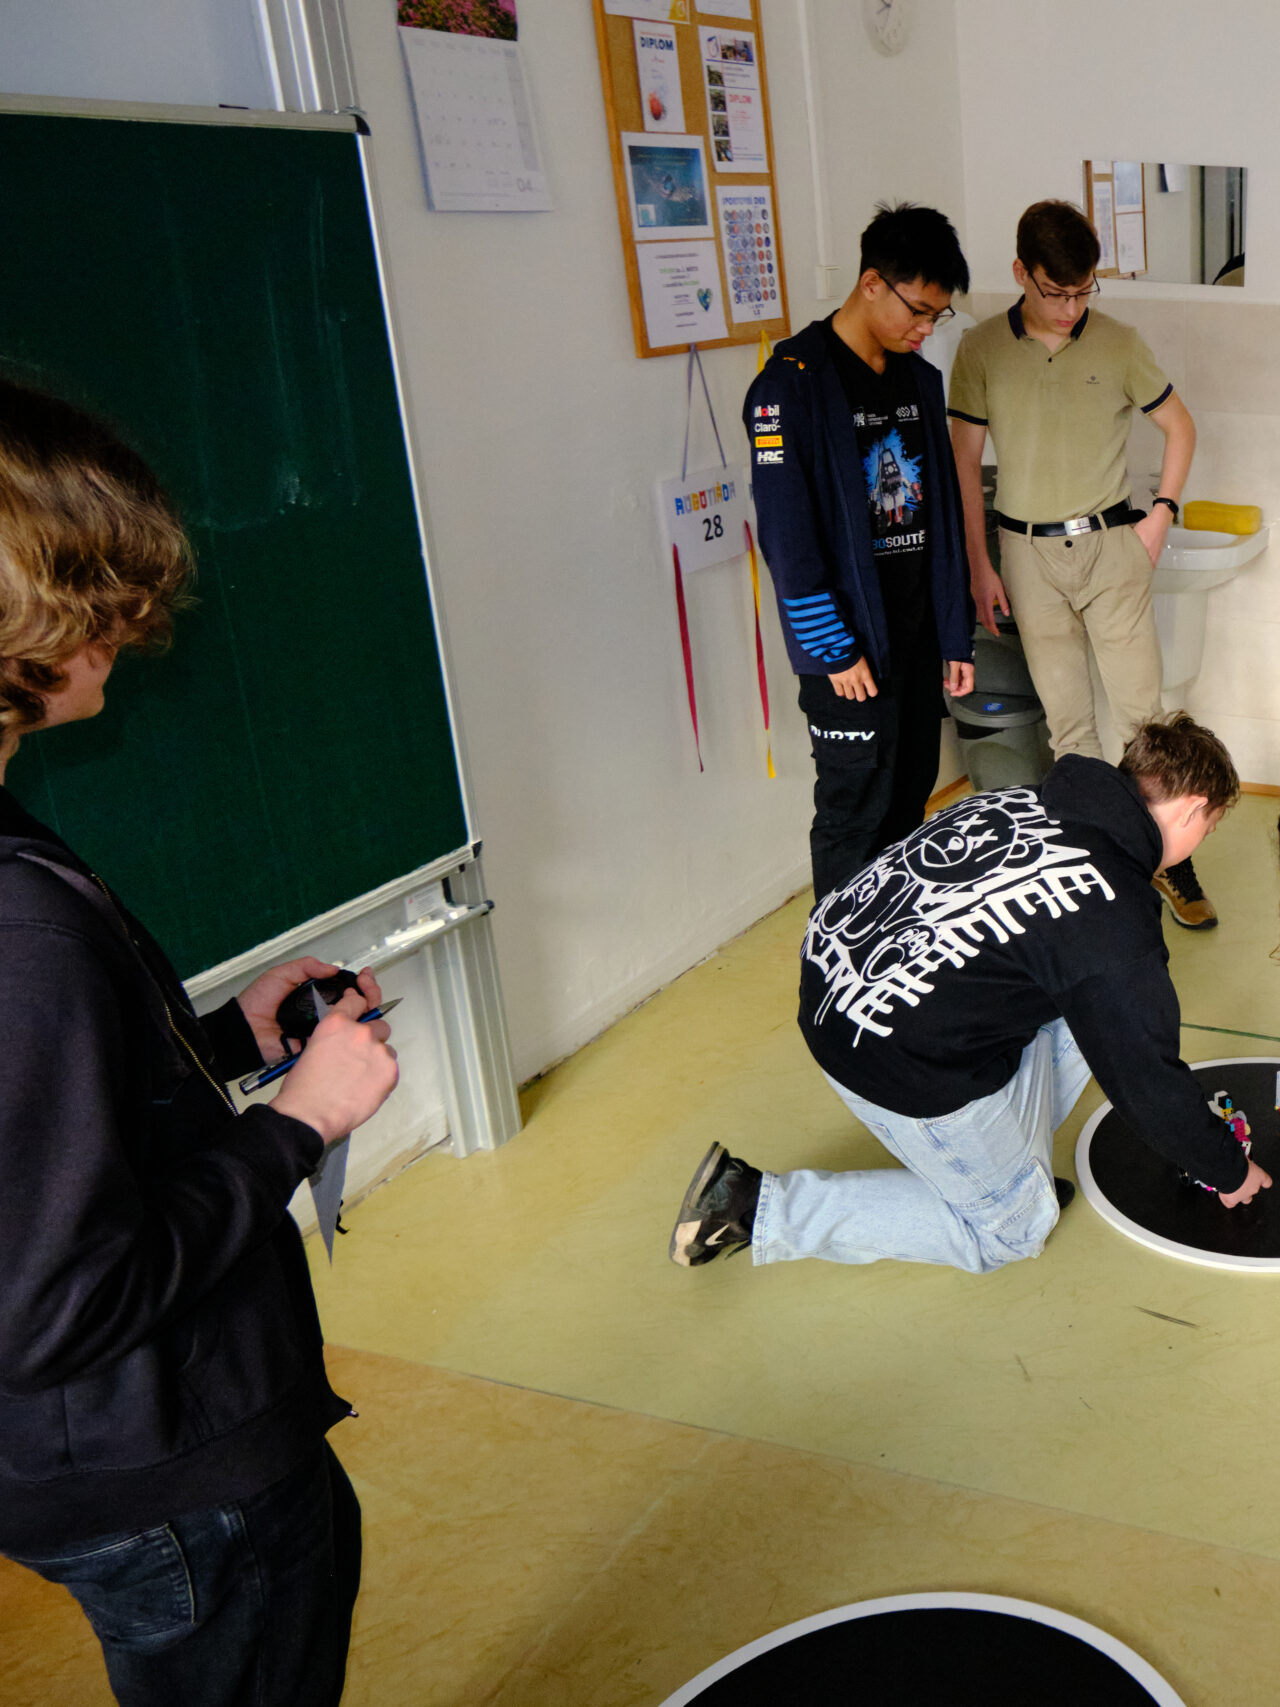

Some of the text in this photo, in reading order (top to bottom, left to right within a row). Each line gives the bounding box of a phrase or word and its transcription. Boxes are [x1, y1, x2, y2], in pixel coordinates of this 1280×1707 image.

[640, 36, 674, 51] DIPLOM
[754, 404, 780, 417] Mobil
[755, 420, 780, 432] Claro
[757, 450, 784, 462] HRC
[702, 514, 724, 541] 28
